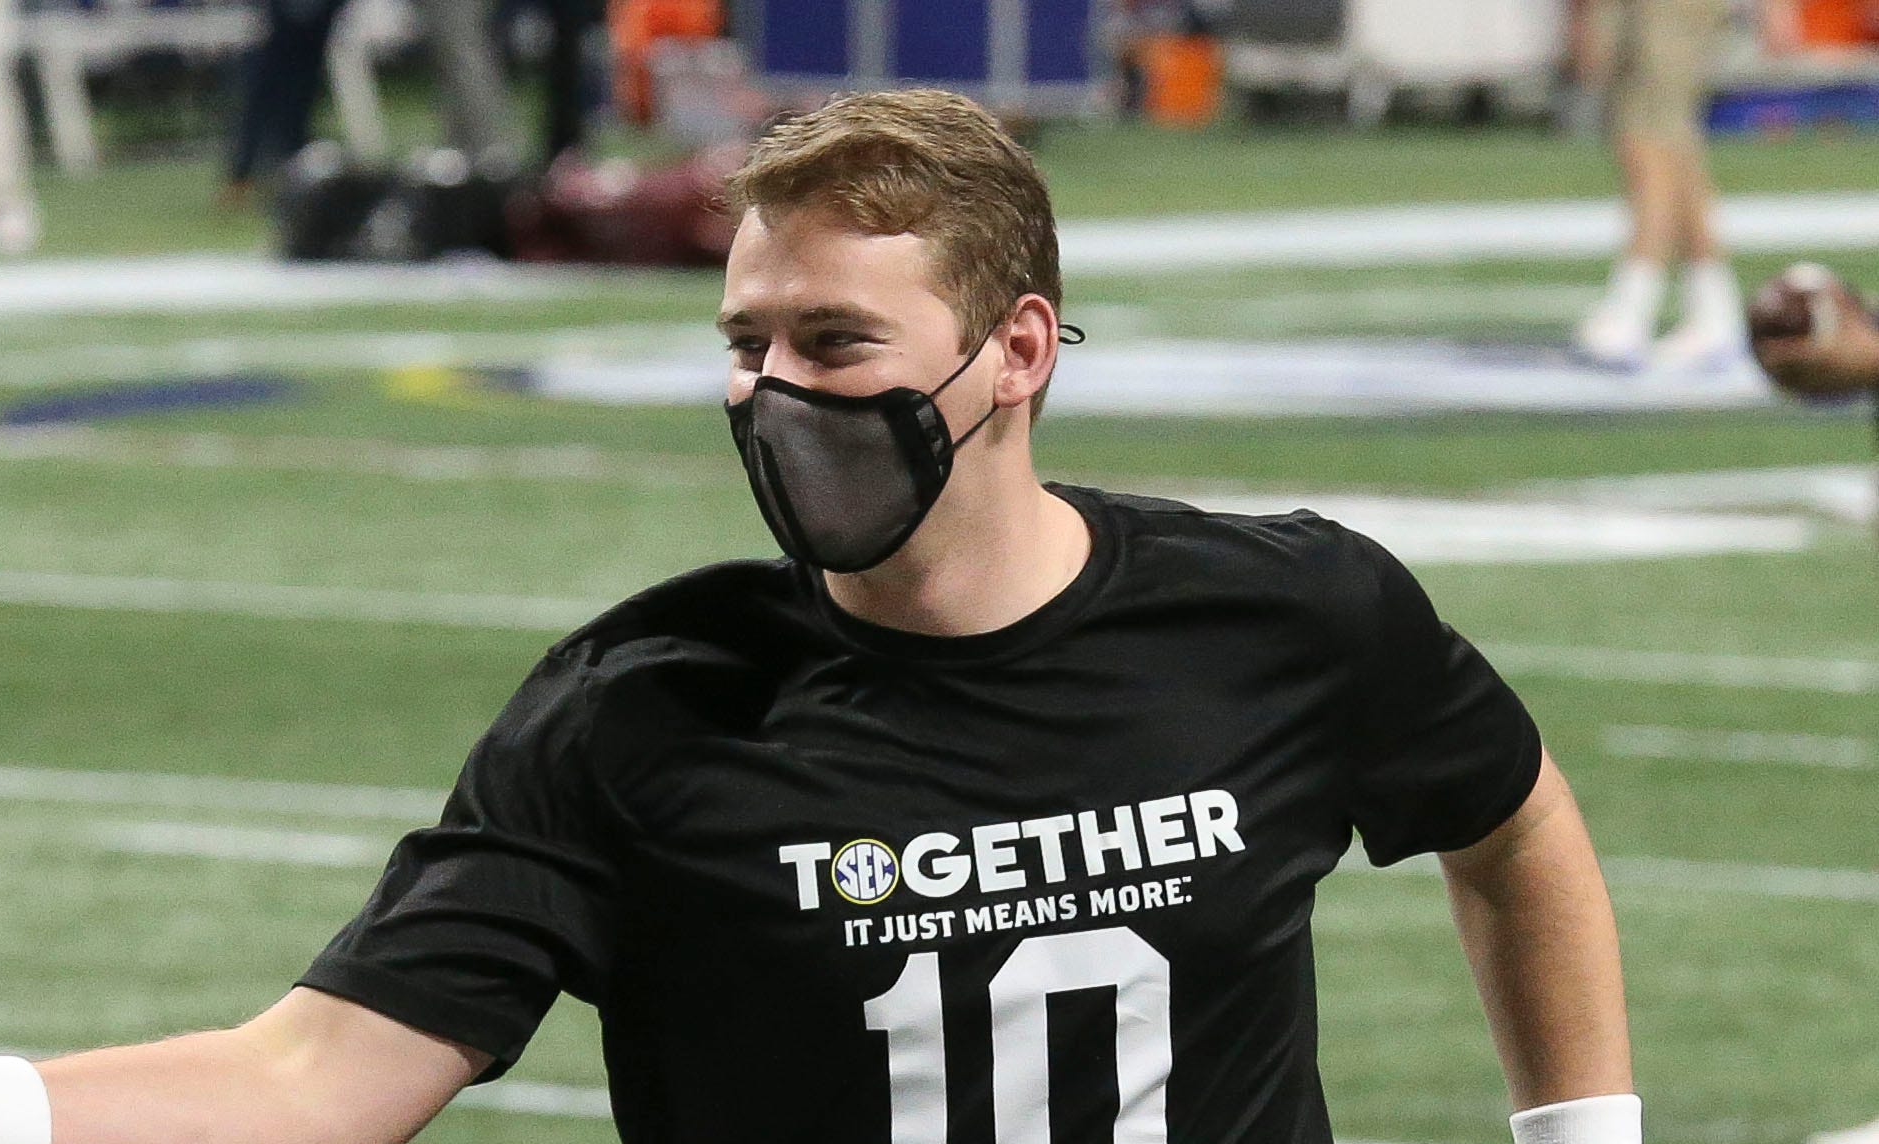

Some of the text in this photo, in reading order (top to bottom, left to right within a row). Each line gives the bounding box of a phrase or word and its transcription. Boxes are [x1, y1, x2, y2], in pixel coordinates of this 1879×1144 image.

[835, 842, 896, 901] SEC
[844, 918, 873, 947] IT
[879, 910, 955, 944] JUST
[964, 893, 1078, 934] MEANS
